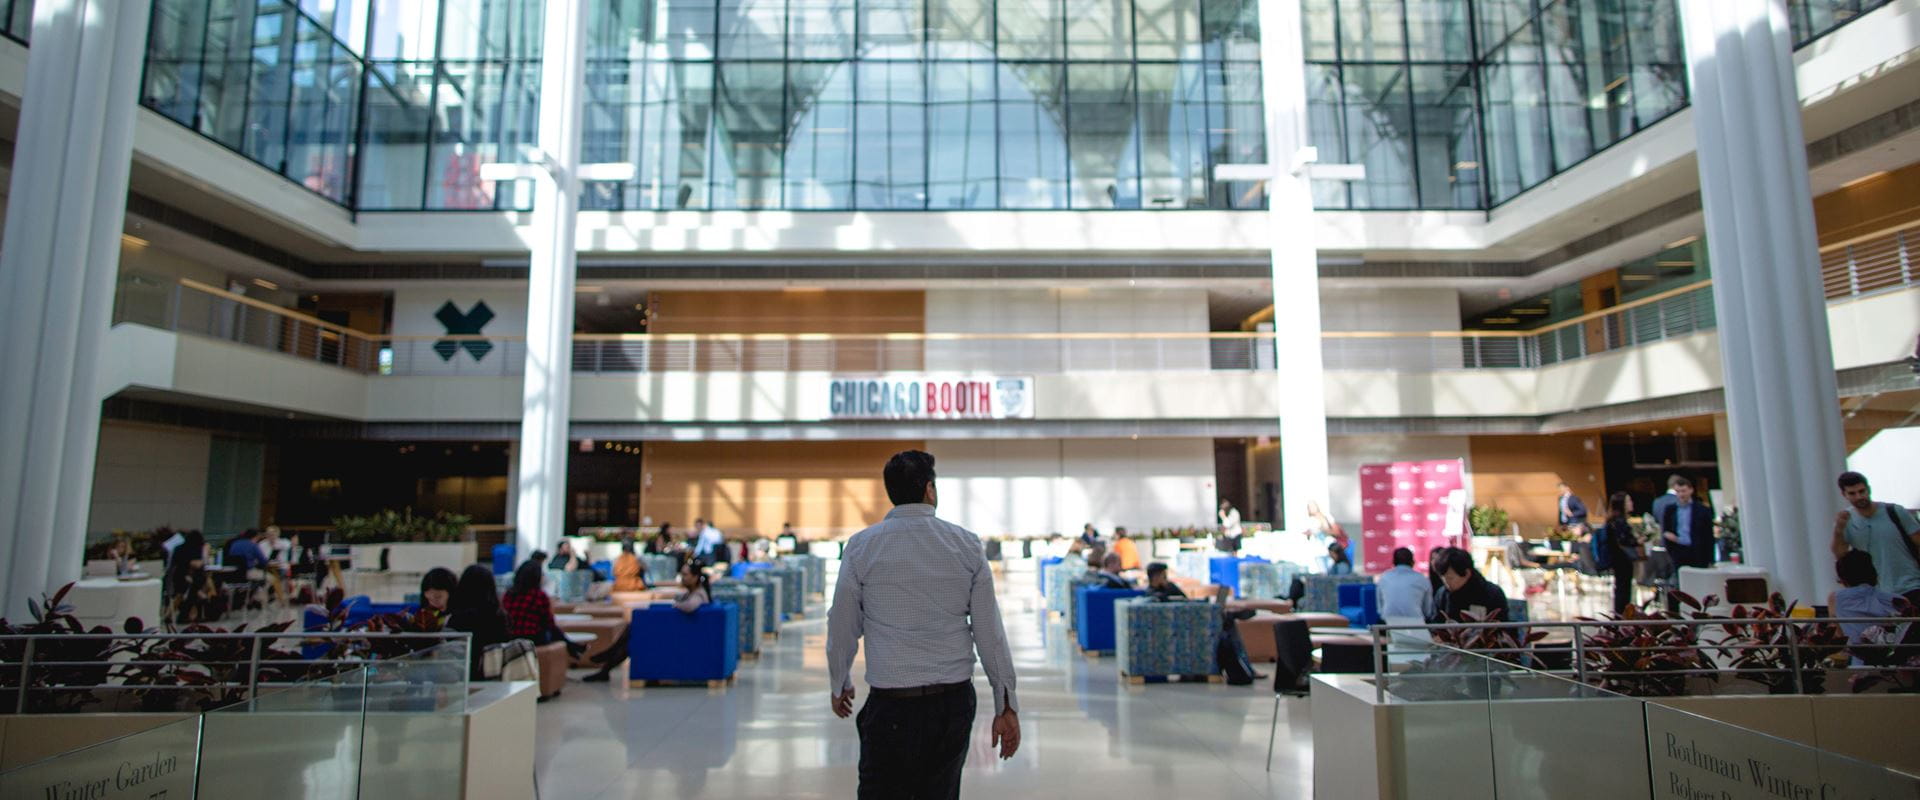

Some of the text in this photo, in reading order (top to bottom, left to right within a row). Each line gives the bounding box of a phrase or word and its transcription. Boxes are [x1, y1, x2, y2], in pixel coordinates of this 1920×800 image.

[830, 381, 991, 414] CHICAGO BOOTH
[116, 752, 177, 792] Garden
[1665, 732, 1814, 800] Rothman Winter
